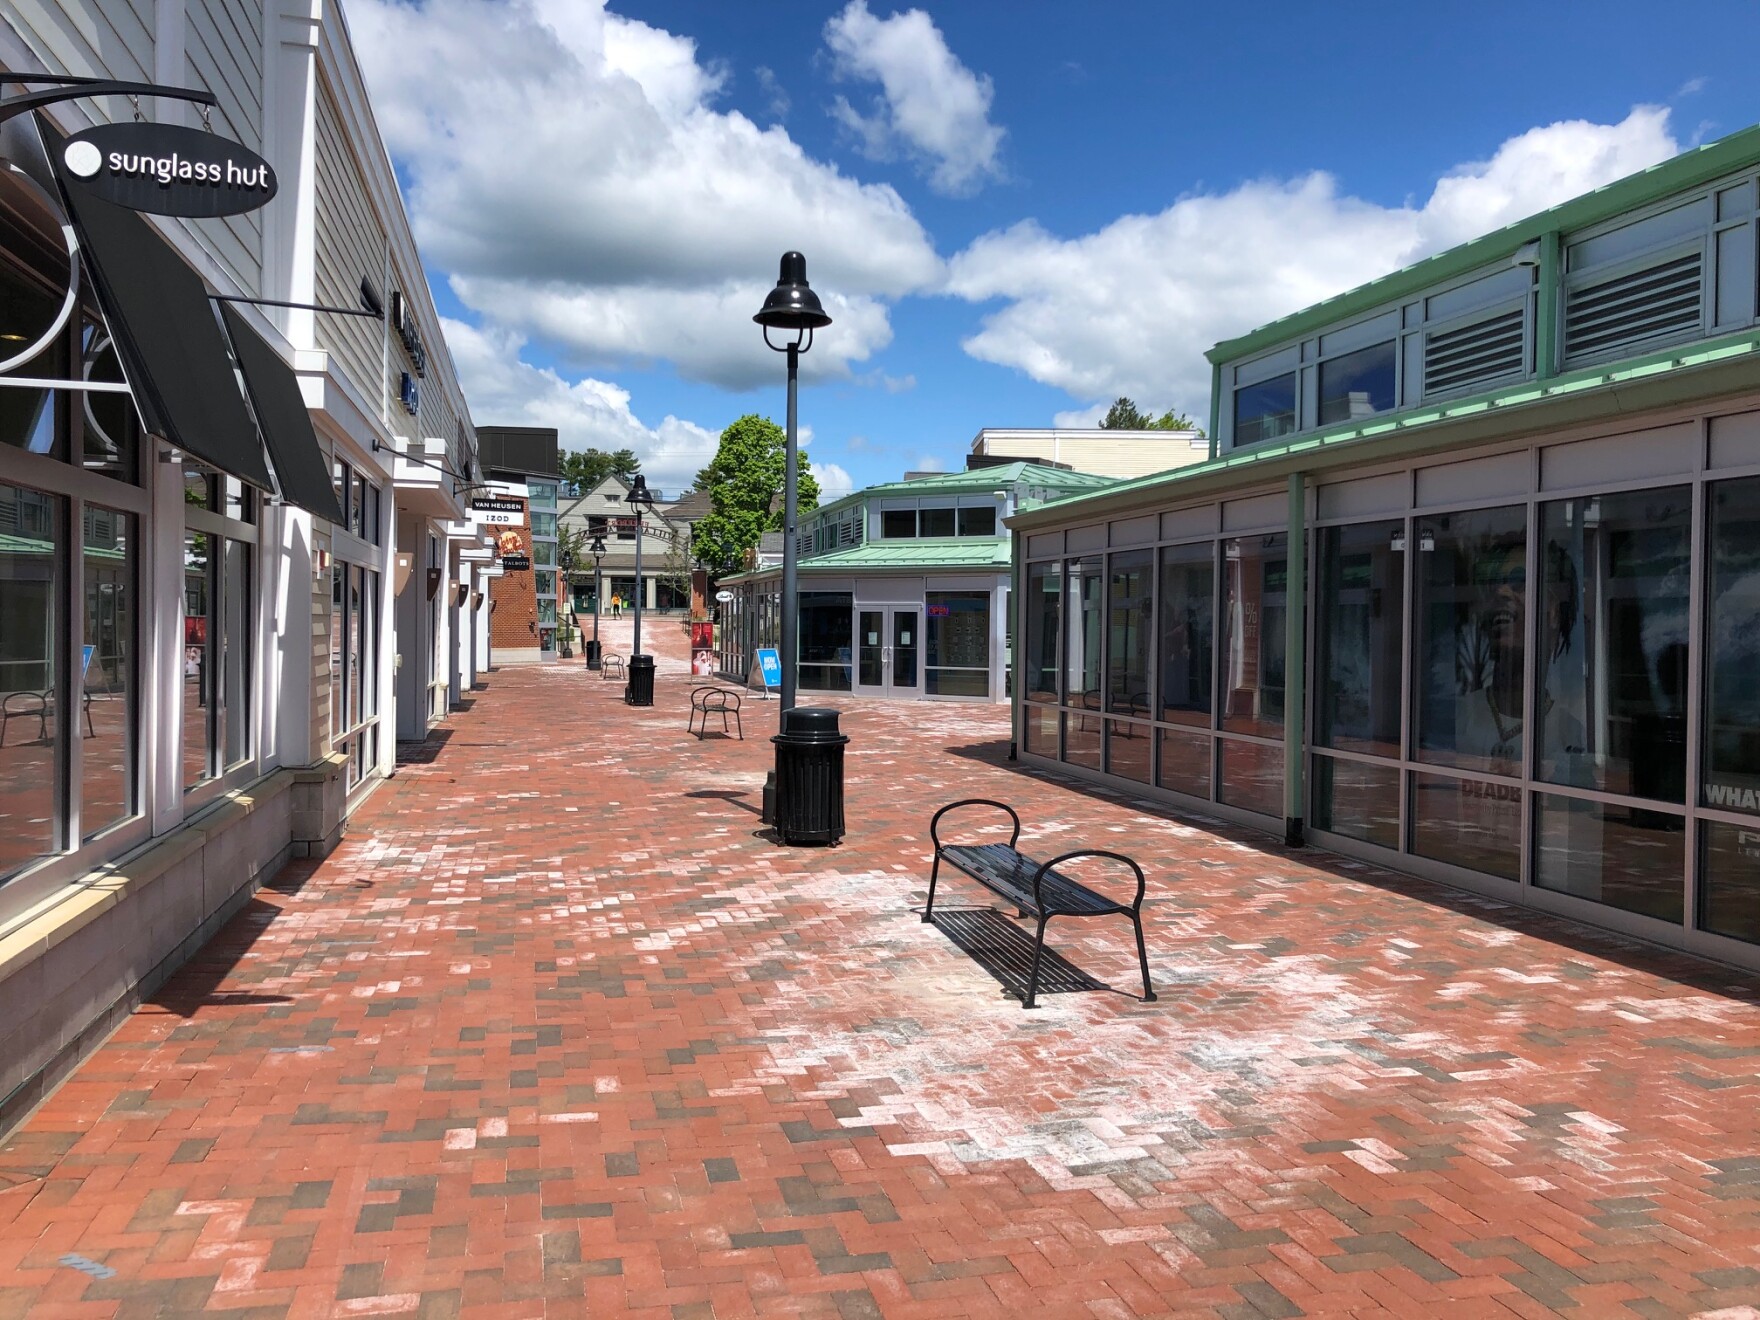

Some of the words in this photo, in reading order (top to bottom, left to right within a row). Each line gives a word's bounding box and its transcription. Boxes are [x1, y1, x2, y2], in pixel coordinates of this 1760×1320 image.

[109, 152, 221, 183] sunglass
[227, 159, 268, 187] hut
[928, 606, 948, 615] OPEN
